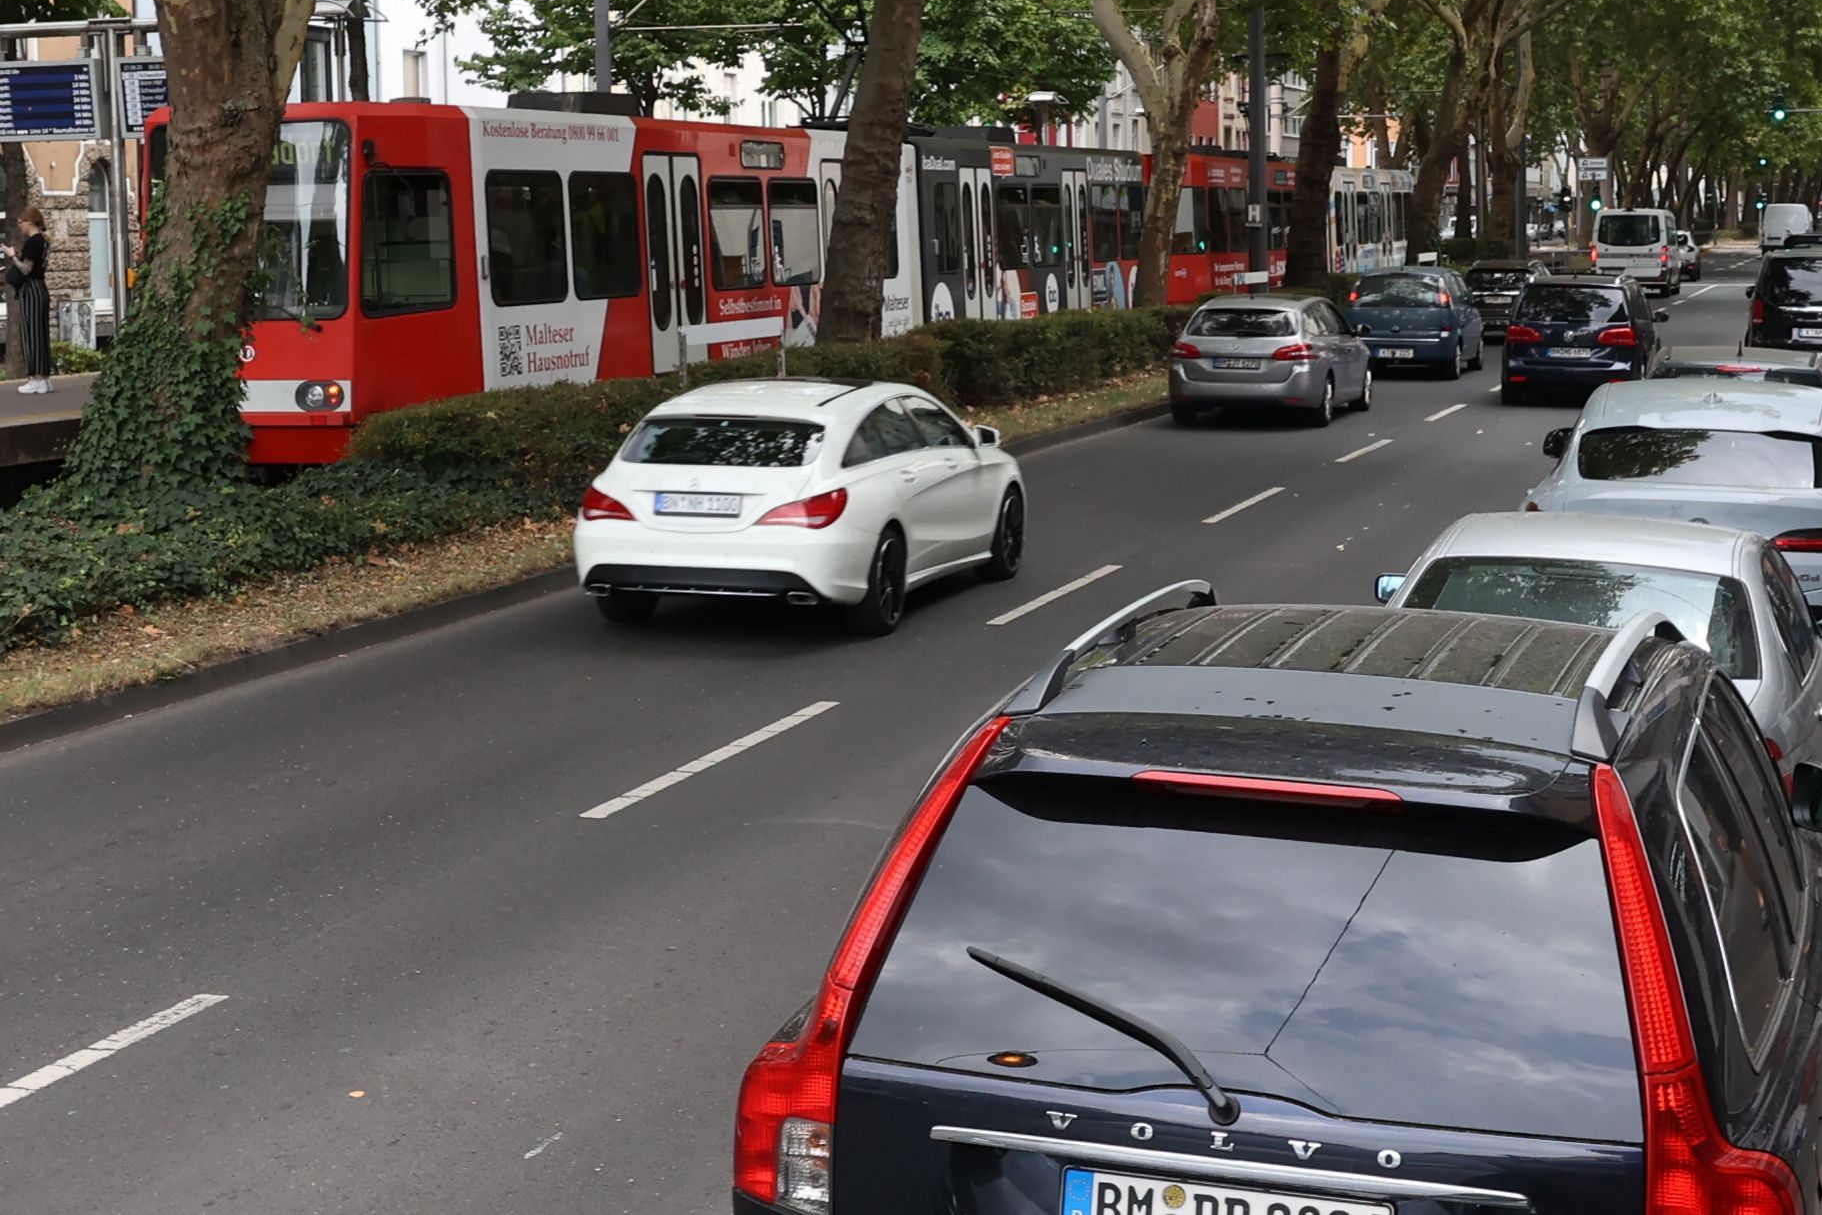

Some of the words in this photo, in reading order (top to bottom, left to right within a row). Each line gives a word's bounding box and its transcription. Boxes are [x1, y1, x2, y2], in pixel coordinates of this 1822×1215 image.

[482, 120, 529, 138] Kostenlose
[530, 122, 567, 144] Beratung
[568, 124, 585, 140] 0800
[586, 125, 596, 140] 99
[597, 126, 605, 141] 66
[606, 127, 619, 142] 001
[1086, 156, 1113, 181] Duales
[1248, 204, 1261, 223] H
[719, 296, 773, 316] Selbstbestimmt
[526, 323, 574, 346] Malteser
[527, 345, 590, 373] Hausnotruf
[1045, 1110, 1402, 1169] VOLVO
[1096, 1182, 1154, 1215] BM
